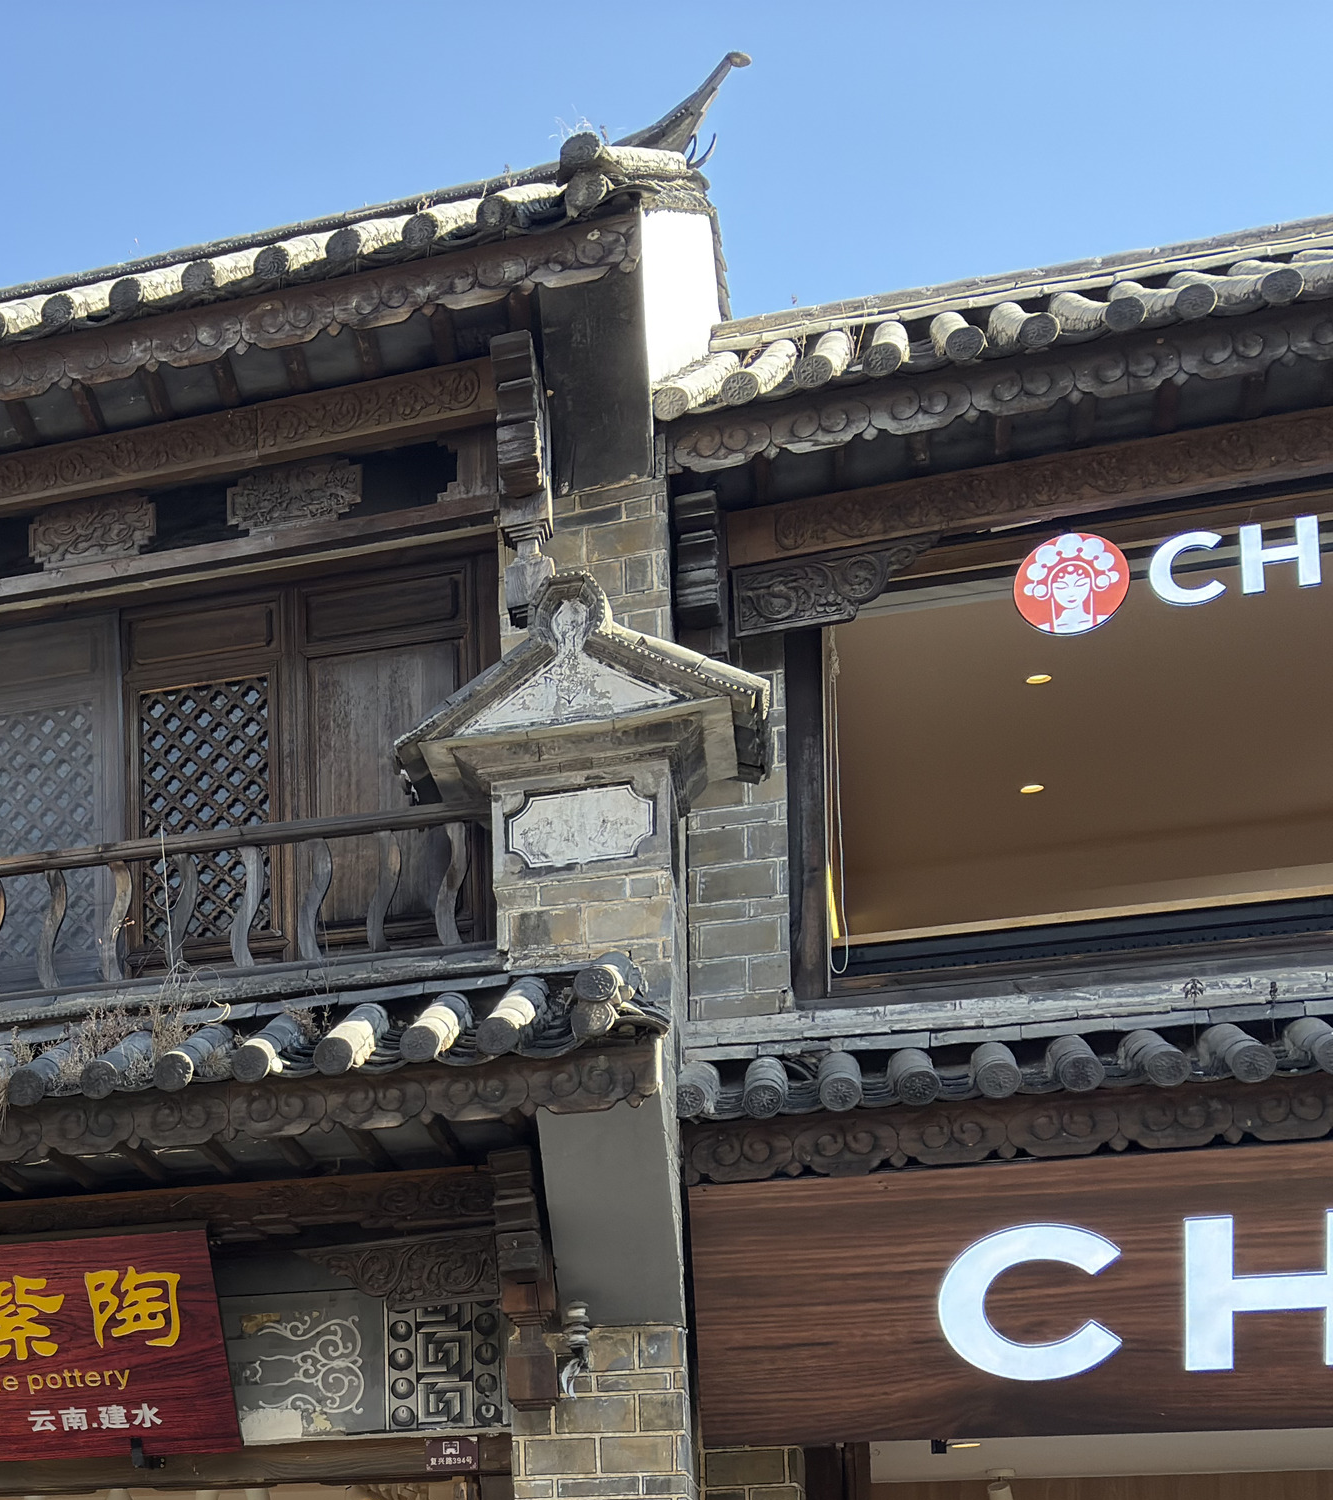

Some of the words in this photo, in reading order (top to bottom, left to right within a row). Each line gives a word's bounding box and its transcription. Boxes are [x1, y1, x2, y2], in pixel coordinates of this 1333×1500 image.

[1149, 515, 1322, 606] CH
[938, 1209, 1333, 1382] CH
[26, 1367, 131, 1396] pottery
